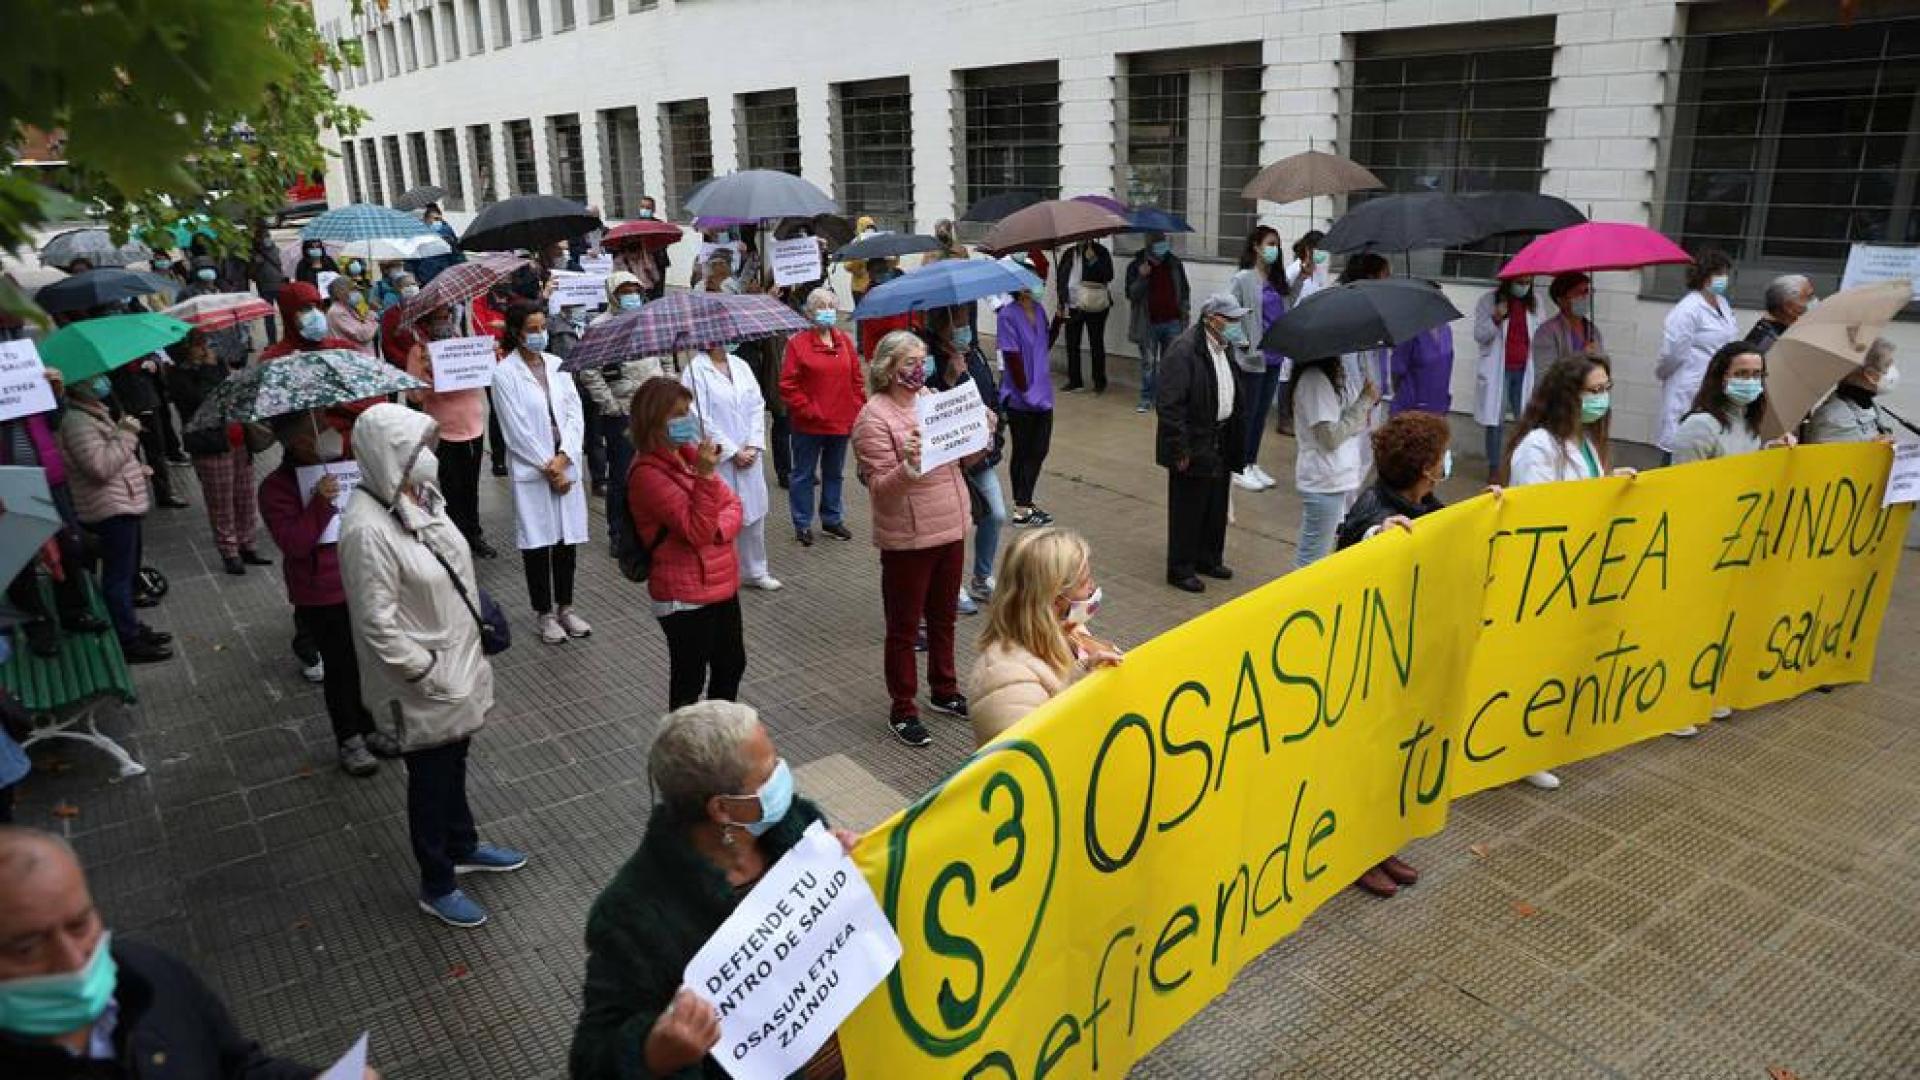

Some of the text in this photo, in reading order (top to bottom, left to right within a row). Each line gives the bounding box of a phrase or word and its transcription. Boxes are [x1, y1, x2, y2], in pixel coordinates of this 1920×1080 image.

[1084, 564, 1420, 873] OSASUN
[1400, 718, 1450, 818] tu
[706, 871, 818, 994] DEFIENDE TU
[714, 870, 847, 1020] NTRO DE SALUD
[733, 922, 856, 1060] OSASUN ETXEA
[778, 969, 839, 1048] ZAINDU
